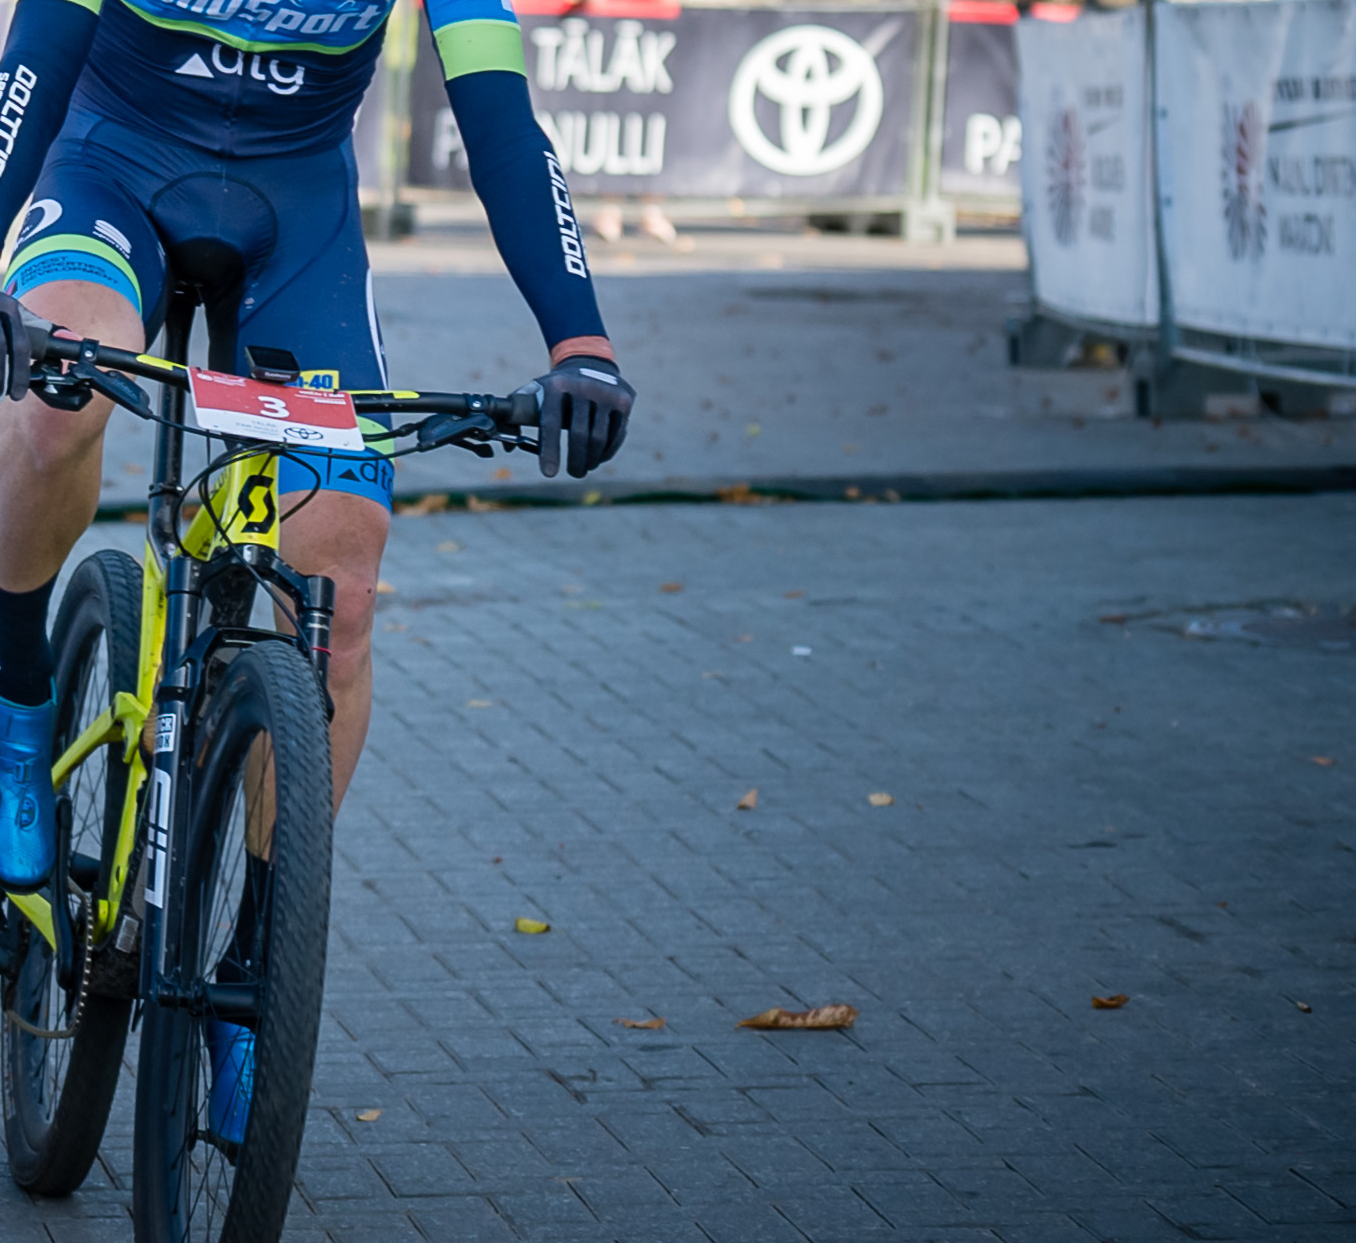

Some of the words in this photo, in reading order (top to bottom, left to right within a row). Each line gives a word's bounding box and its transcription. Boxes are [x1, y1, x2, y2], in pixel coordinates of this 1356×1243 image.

[530, 16, 677, 94] TĀLĀK
[257, 395, 290, 419] 3
[360, 459, 393, 492] dt
